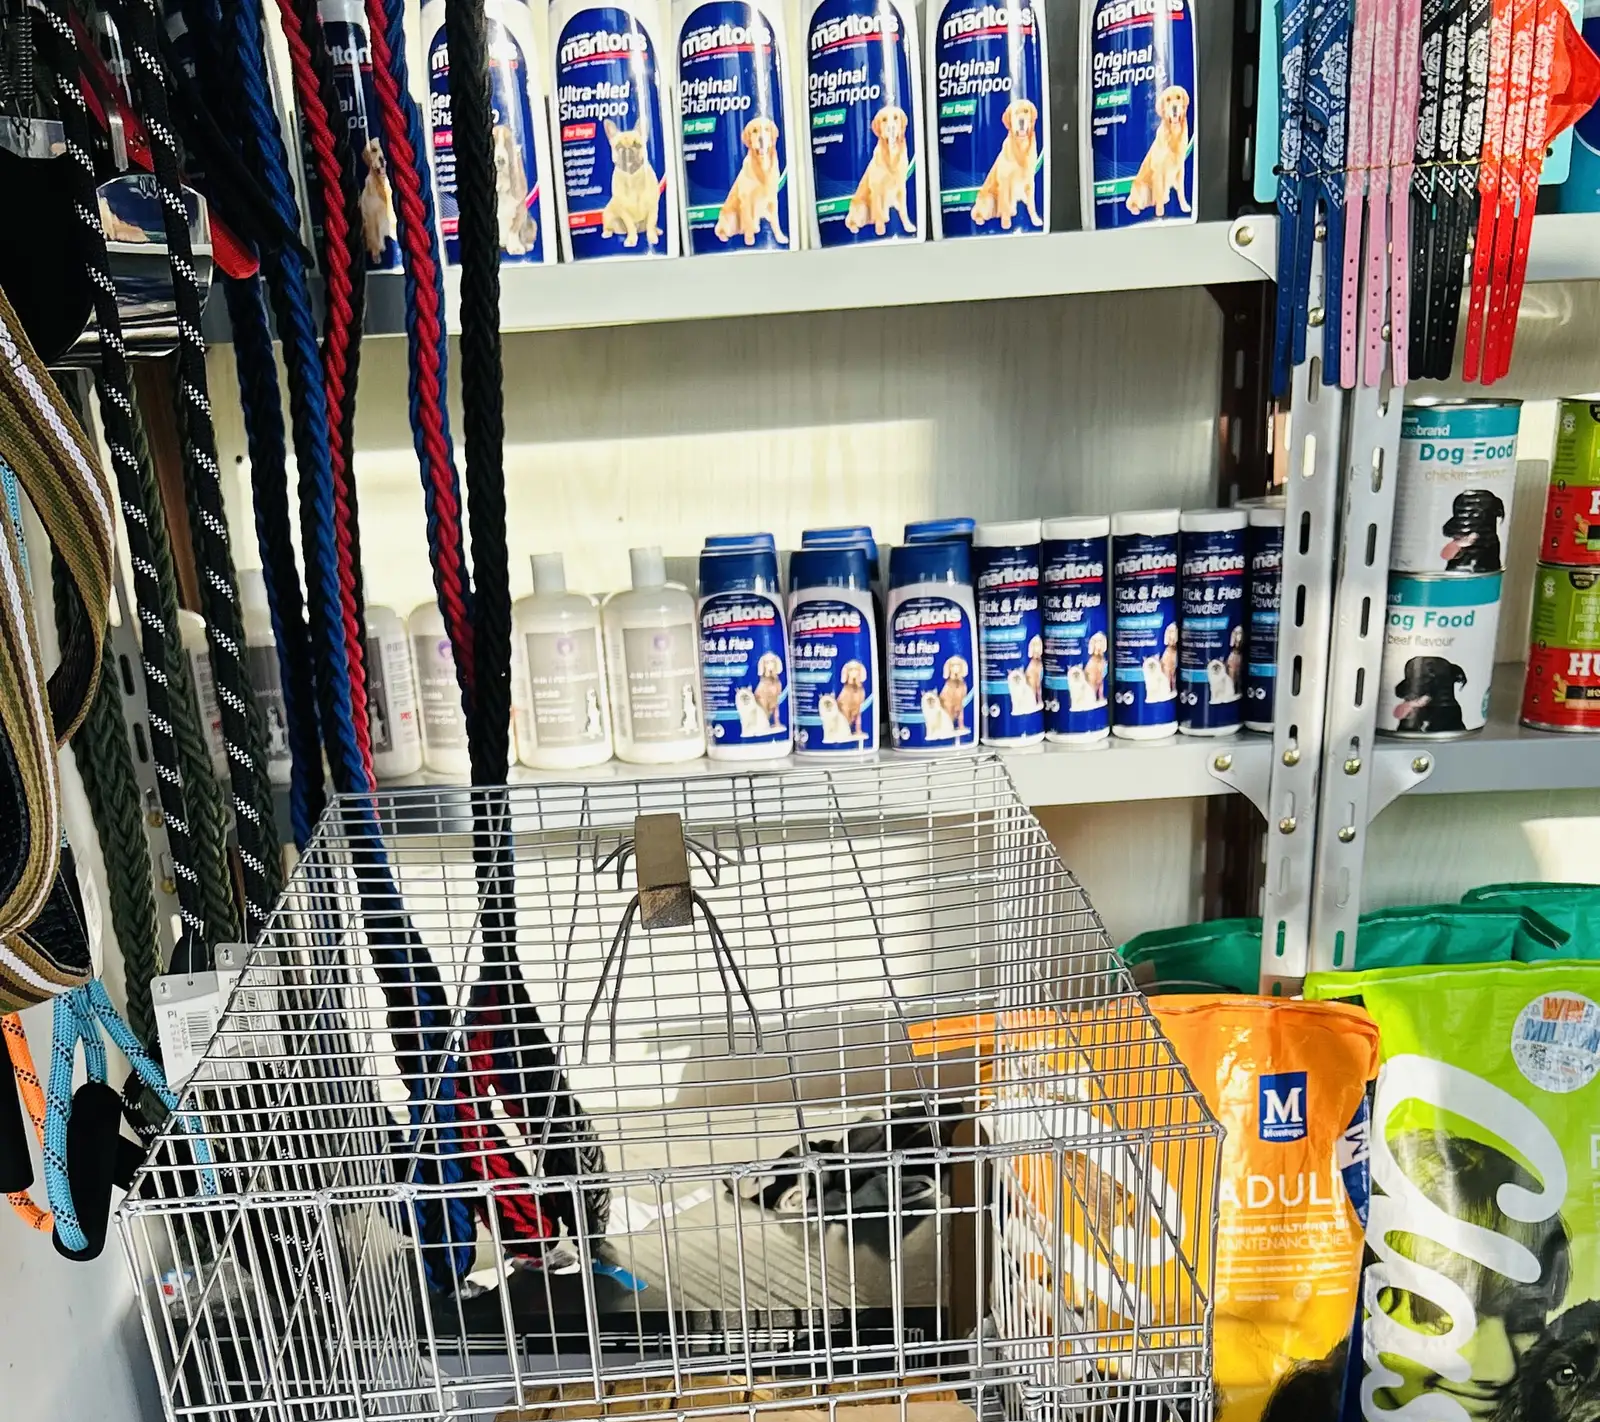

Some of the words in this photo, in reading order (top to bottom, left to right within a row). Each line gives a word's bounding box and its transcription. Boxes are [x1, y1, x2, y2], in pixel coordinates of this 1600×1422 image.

[1094, 45, 1153, 71] Original
[809, 65, 868, 91] Original
[939, 57, 1001, 81] Original
[558, 80, 630, 104] Ultra-Med
[680, 76, 738, 98] Original
[810, 84, 880, 108] Shampoo
[939, 76, 1012, 98] Shampoo
[680, 95, 751, 115] Shampoo
[942, 105, 954, 115] For
[955, 103, 973, 116] Dogs
[1096, 96, 1107, 107] For
[1108, 93, 1129, 106] Dogs
[559, 101, 629, 121] Shampoo
[813, 114, 824, 125] For
[825, 112, 843, 125] Dogs
[1419, 443, 1464, 465] Dog
[1075, 592, 1101, 608] Flea
[1217, 586, 1242, 600] Flea
[1014, 596, 1038, 612] Flea
[1388, 612, 1415, 631] og
[1423, 610, 1476, 628] Food
[1263, 1087, 1303, 1125] M
